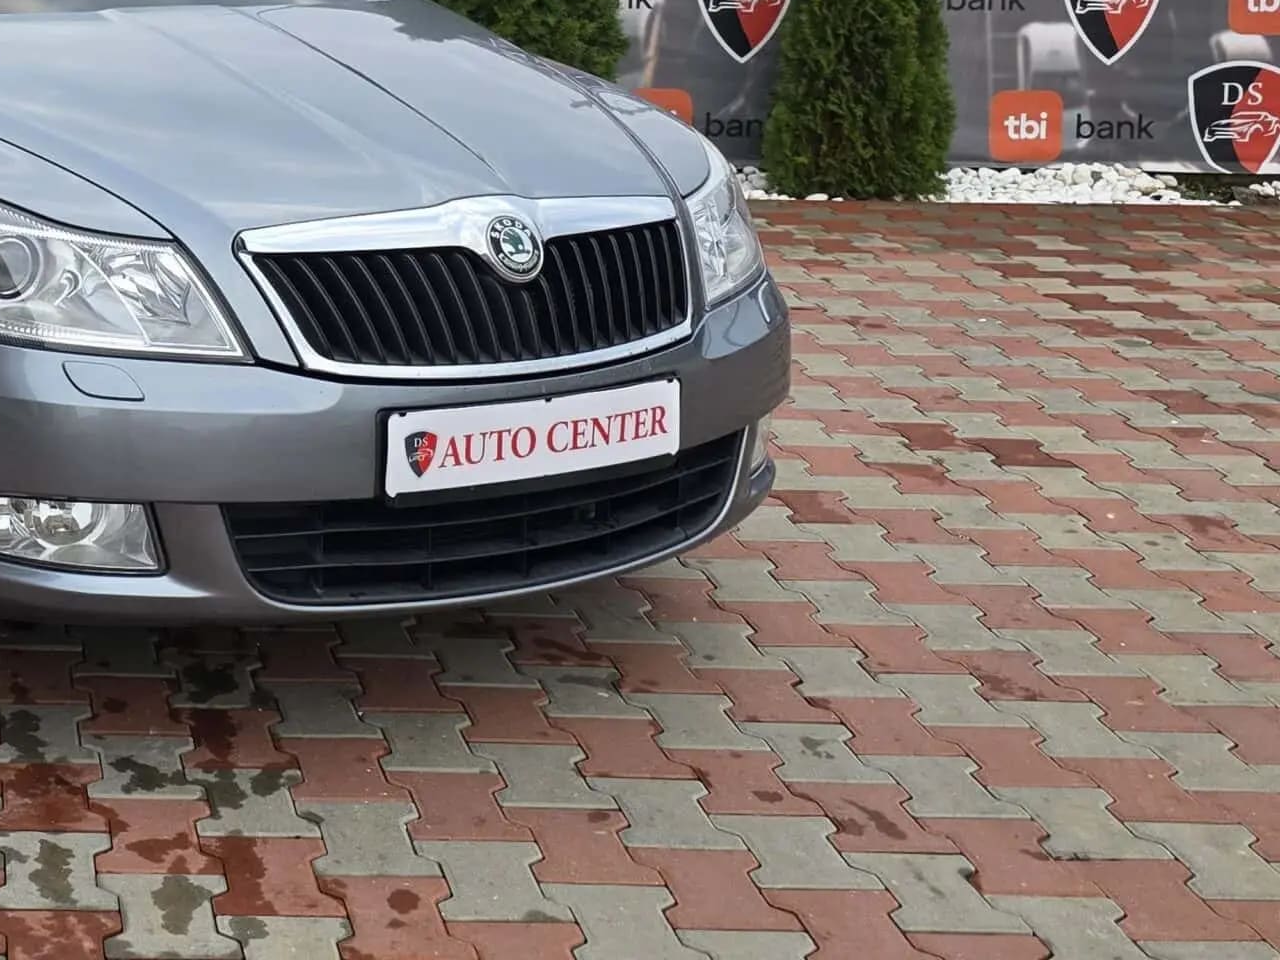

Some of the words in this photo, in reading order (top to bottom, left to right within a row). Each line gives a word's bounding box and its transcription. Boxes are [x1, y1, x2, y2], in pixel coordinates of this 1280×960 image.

[1221, 82, 1263, 106] DS
[705, 112, 763, 138] ban
[1004, 112, 1048, 140] tbi
[1076, 113, 1156, 139] bank
[414, 437, 428, 448] DS
[439, 426, 536, 468] AUTO
[546, 405, 669, 453] CENTER
